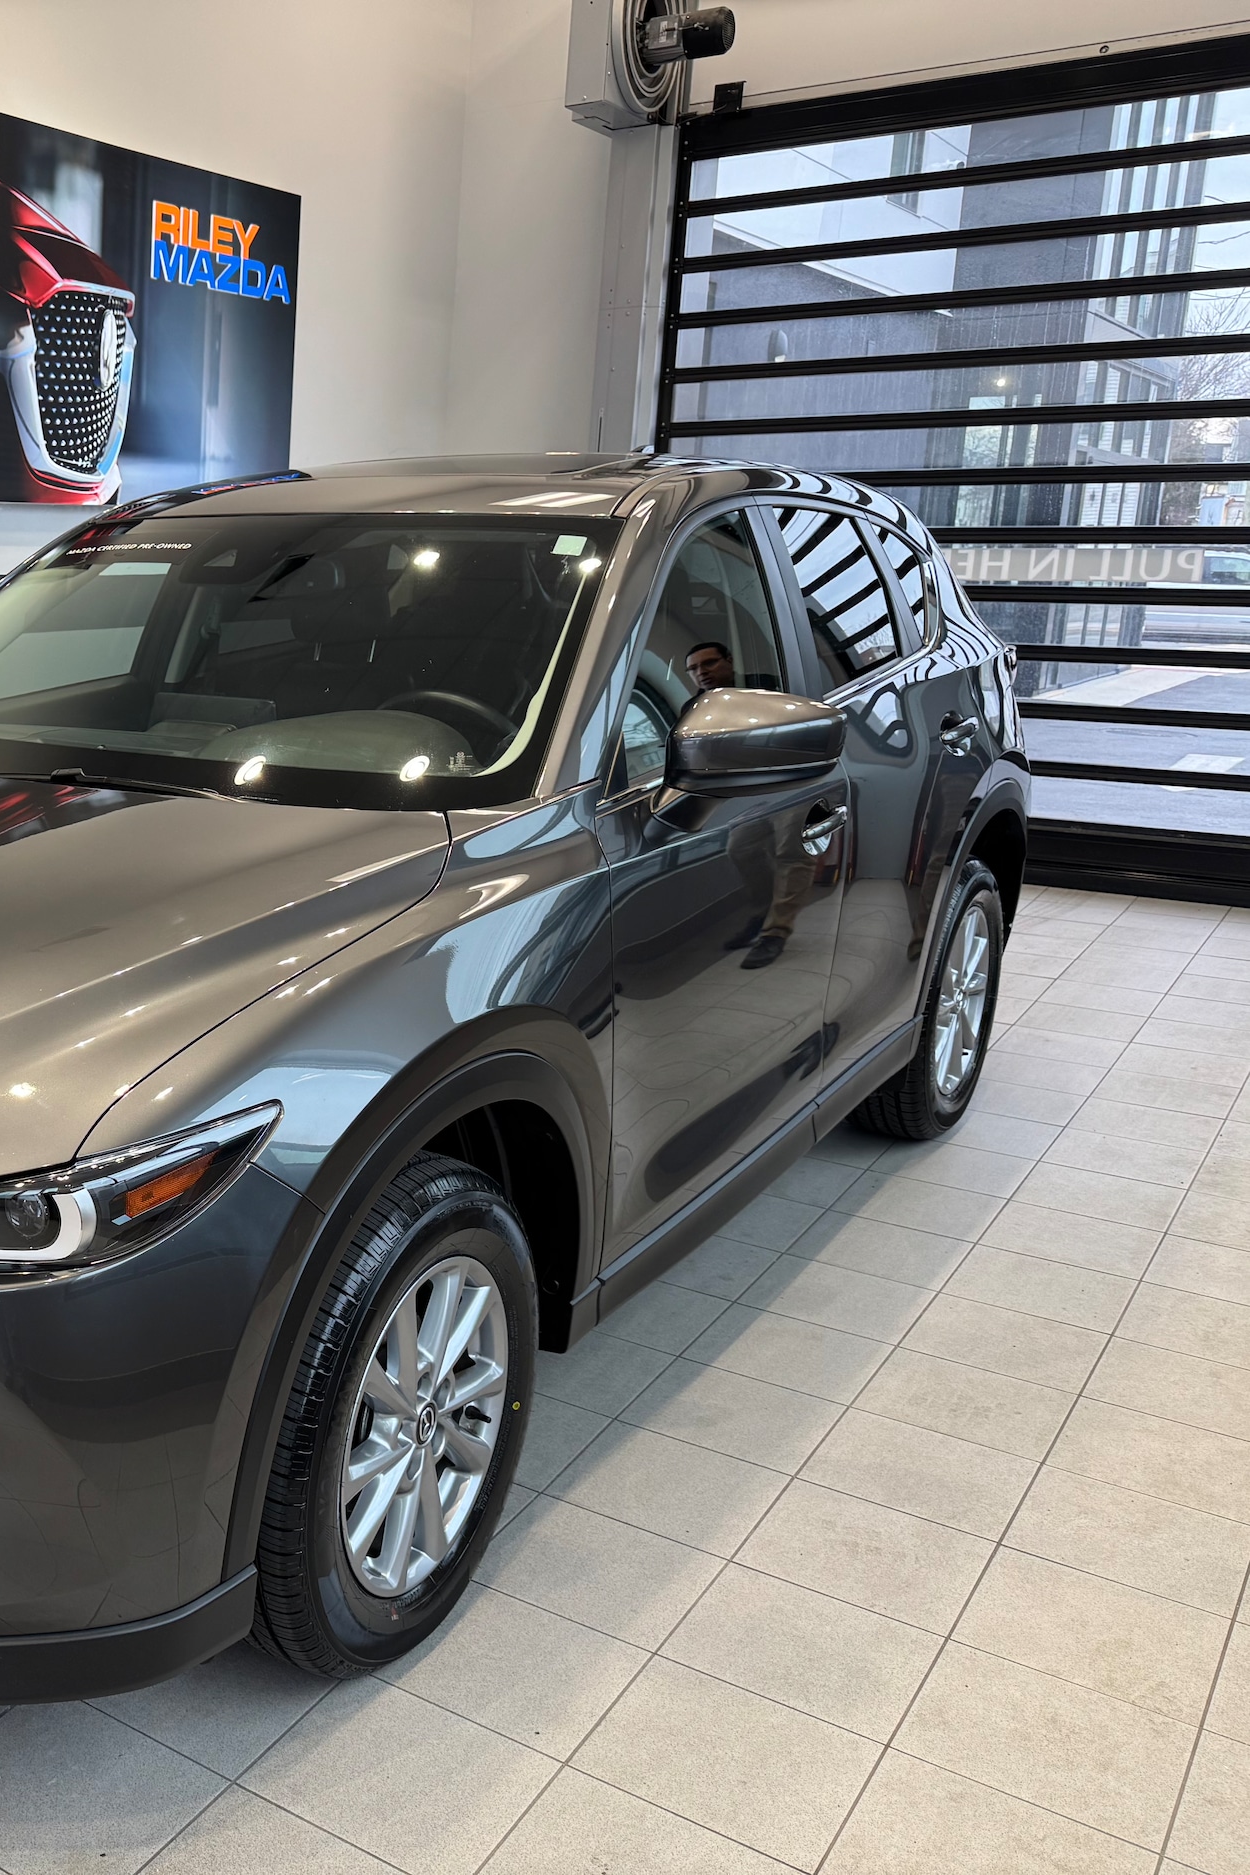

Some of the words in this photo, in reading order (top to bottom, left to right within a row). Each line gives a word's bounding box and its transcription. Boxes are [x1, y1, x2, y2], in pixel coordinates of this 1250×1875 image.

[152, 200, 260, 259] RILEY
[150, 240, 291, 304] MAZDA
[66, 547, 96, 555] MAZDA
[97, 543, 137, 552] CERTIFIED
[137, 542, 192, 550] PRE-OWNED
